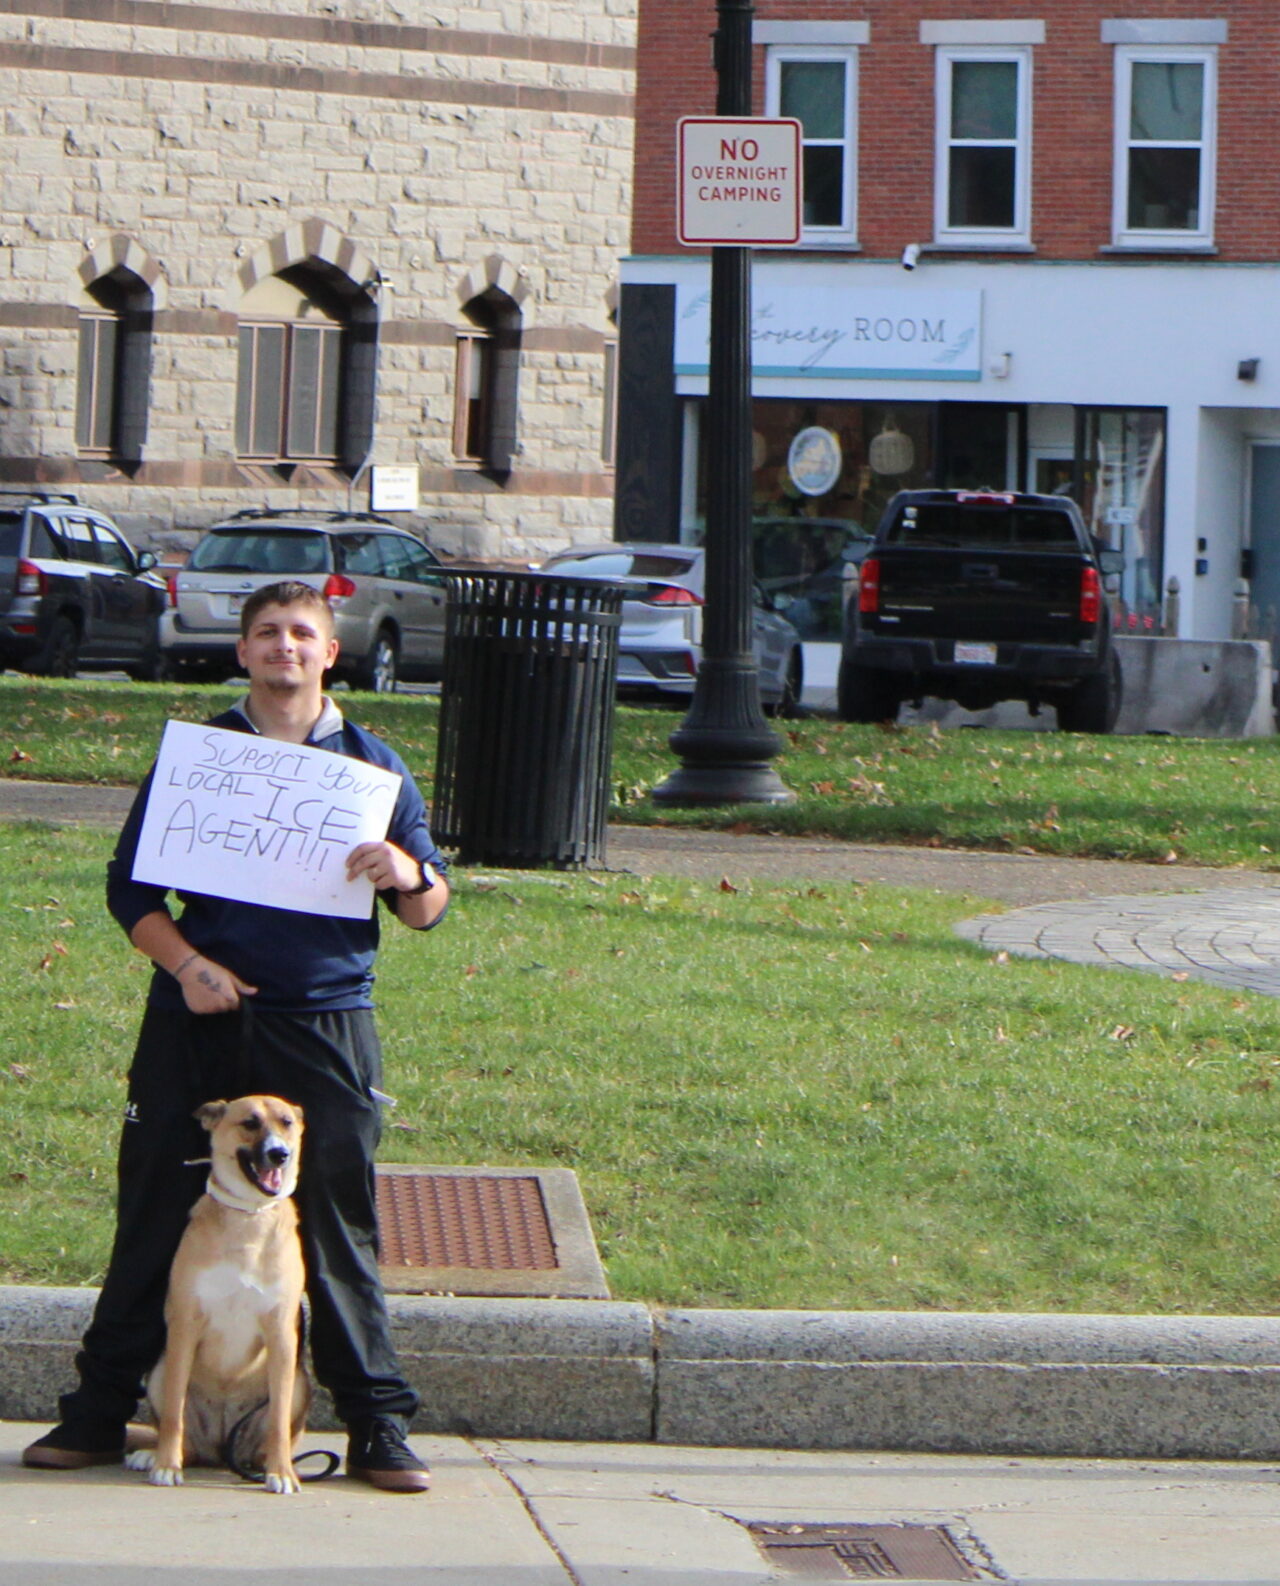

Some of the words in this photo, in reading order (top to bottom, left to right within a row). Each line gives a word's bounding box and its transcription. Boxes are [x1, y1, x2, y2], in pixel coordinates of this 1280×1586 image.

[720, 139, 759, 161] NO
[691, 165, 788, 180] OVERNIGHT
[698, 186, 782, 202] CAMPING
[853, 317, 946, 343] ROOM
[317, 763, 391, 796] your
[169, 766, 254, 797] LOCAL
[253, 778, 361, 845] ICE
[158, 799, 329, 881] AGENT!!!
